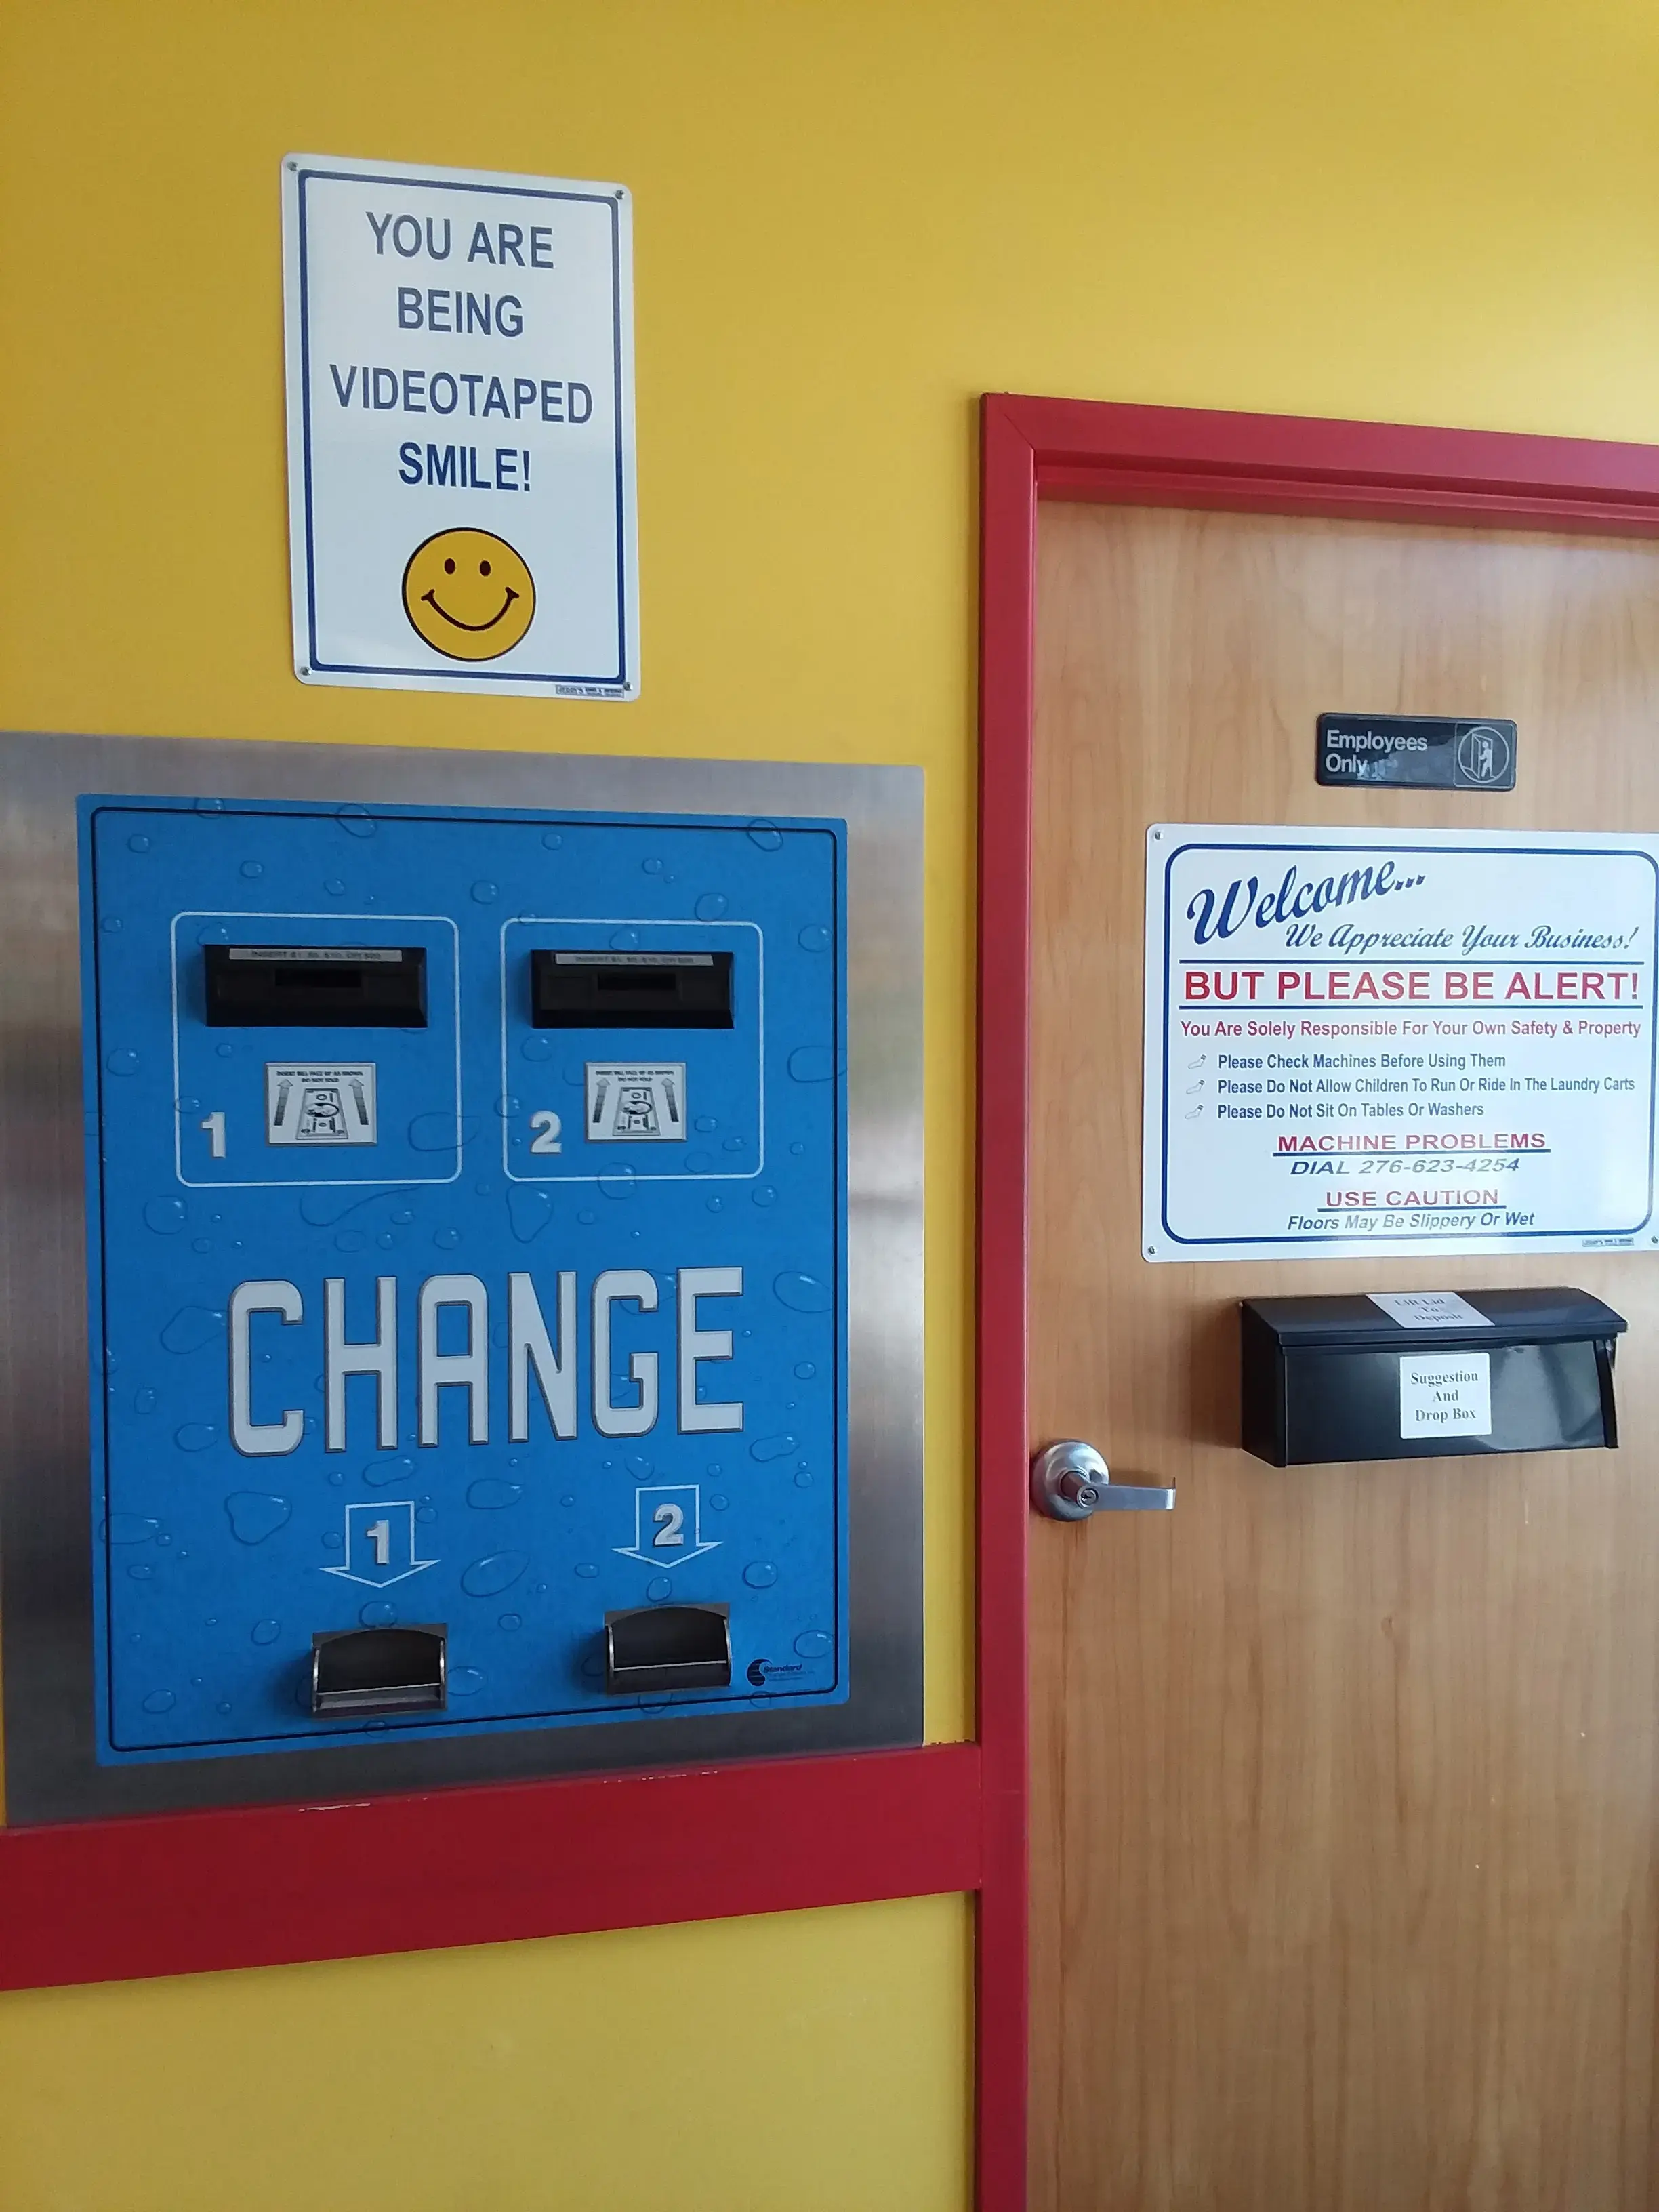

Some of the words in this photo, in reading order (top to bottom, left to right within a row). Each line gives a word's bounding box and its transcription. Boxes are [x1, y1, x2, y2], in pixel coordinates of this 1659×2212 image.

[366, 211, 451, 260] YOU
[467, 222, 554, 268] ARE
[397, 287, 523, 337] BEING
[329, 364, 592, 424] VIDEOTAPED
[398, 441, 531, 491] SMILE!
[1326, 729, 1428, 753] Employees
[1326, 754, 1368, 777] Only
[1286, 924, 1323, 948] We
[1328, 924, 1454, 955] Appreciate
[1462, 924, 1520, 956] Your
[1524, 925, 1639, 949] Business!
[1185, 972, 1265, 1000] BUT
[1277, 971, 1430, 1000] PLEASE
[1444, 972, 1494, 1000] BE
[1504, 972, 1638, 1000] ALERT!
[1181, 1021, 1210, 1036] You
[1214, 1021, 1242, 1036] Are
[1247, 1021, 1296, 1040] Solely
[1300, 1021, 1397, 1039] Responsible
[1402, 1021, 1429, 1035] For
[1432, 1021, 1468, 1035] Your
[1473, 1021, 1506, 1035] Own
[1511, 1020, 1557, 1038] Safety
[1563, 1020, 1574, 1035] &
[1579, 1020, 1641, 1038] Property
[1218, 1054, 1263, 1069] Please
[1267, 1054, 1309, 1068] Check
[1313, 1054, 1376, 1068] Machines
[1381, 1054, 1424, 1067] Before
[1429, 1054, 1466, 1070] Using
[1470, 1053, 1506, 1067] Them
[1218, 1080, 1263, 1094] Please
[1267, 1080, 1285, 1093] Do
[1289, 1079, 1313, 1093] Not
[1315, 1079, 1351, 1093] Allow
[1355, 1078, 1408, 1092] Children
[1412, 1079, 1427, 1092] To
[1431, 1078, 1456, 1092] Run
[1460, 1078, 1475, 1092] Or
[1479, 1078, 1506, 1091] Ride
[1510, 1078, 1521, 1091] In
[1525, 1078, 1547, 1090] The
[1551, 1077, 1599, 1094] Laundry
[1604, 1077, 1635, 1090] Carts
[1218, 1105, 1262, 1118] Please
[1267, 1105, 1285, 1118] Do
[1289, 1104, 1312, 1118] Not
[1316, 1103, 1334, 1118] Sit
[1338, 1103, 1356, 1117] On
[1361, 1103, 1404, 1117] Tables
[1408, 1103, 1425, 1116] Or
[1428, 1102, 1484, 1115] Washers
[201, 1112, 226, 1158] 1
[531, 1111, 562, 1153] 2
[1278, 1135, 1396, 1151] MACHINE
[1406, 1133, 1545, 1149] PROBLEMS
[1290, 1160, 1350, 1175] DIAL
[1358, 1158, 1520, 1174] 276-623-4254
[1326, 1192, 1377, 1207] USE
[1386, 1189, 1498, 1206] CAUTION
[1288, 1216, 1339, 1230] Floors
[1345, 1215, 1378, 1231] May
[1382, 1214, 1404, 1228] Be
[1409, 1213, 1476, 1230] Slippery
[1481, 1212, 1500, 1226] Or
[1505, 1212, 1534, 1226] Wet
[228, 1266, 743, 1457] CHANGE
[1410, 1370, 1479, 1387] Suggestion
[1432, 1389, 1458, 1402] And
[1415, 1409, 1448, 1423] Drop
[1453, 1408, 1476, 1420] Box
[653, 1503, 684, 1547] 2
[365, 1519, 390, 1565] 1
